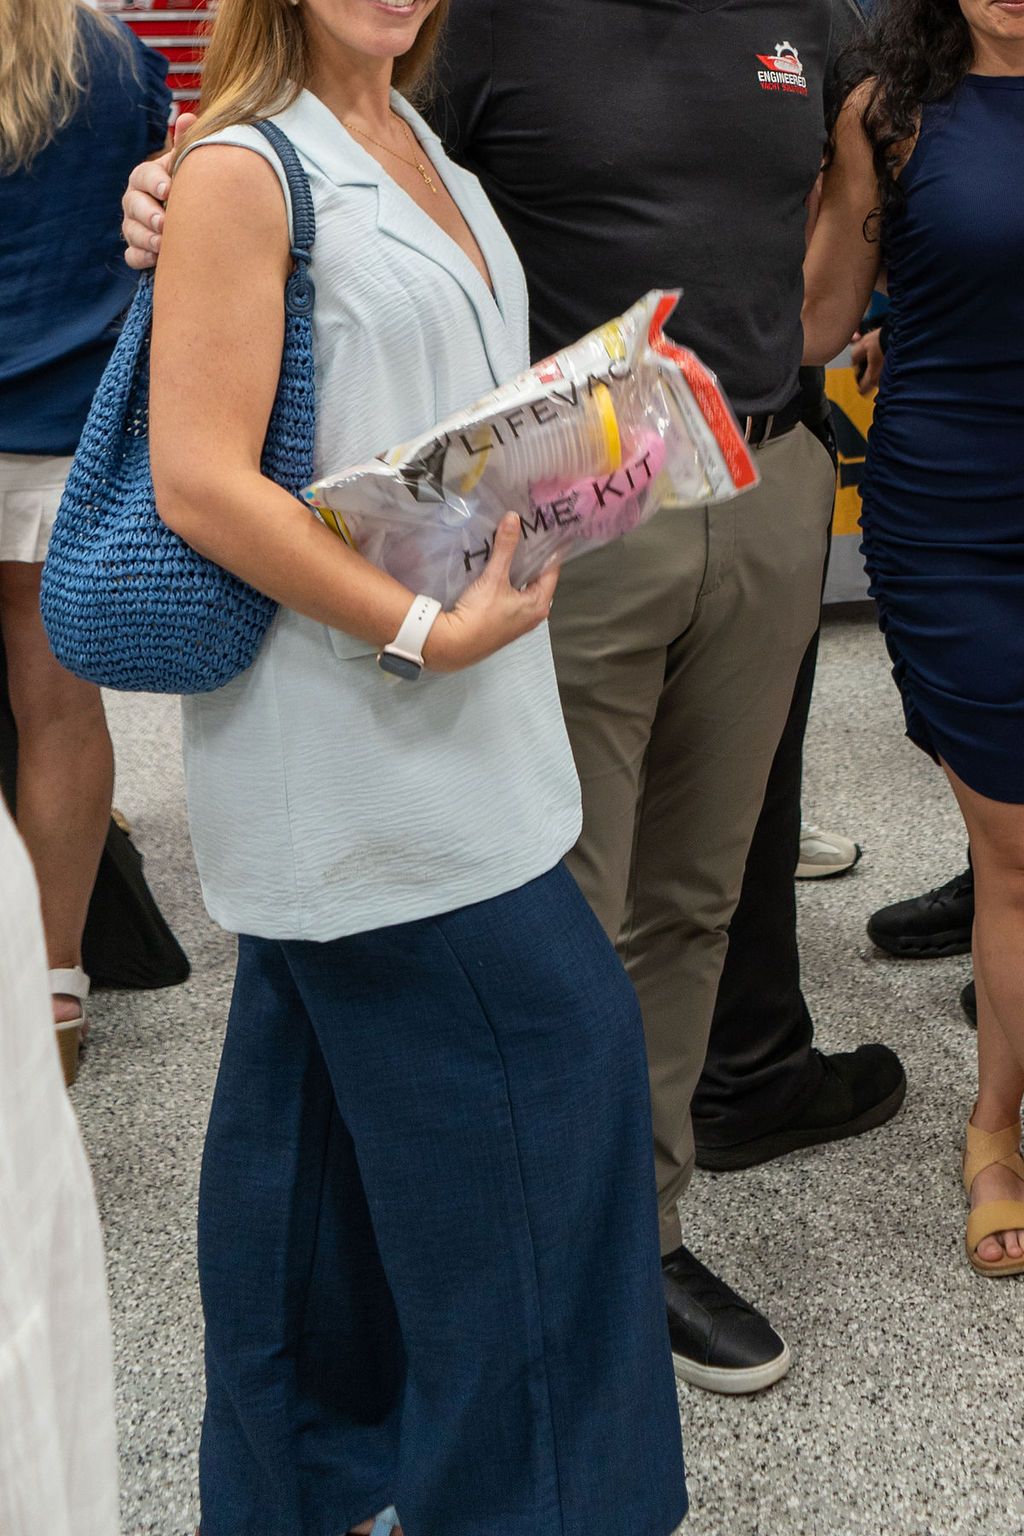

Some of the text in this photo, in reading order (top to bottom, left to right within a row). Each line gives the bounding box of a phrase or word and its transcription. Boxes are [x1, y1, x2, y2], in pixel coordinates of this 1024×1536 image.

[757, 70, 807, 88] ENGINEERED
[459, 362, 632, 457] LIFEVAC
[463, 451, 655, 573] HME KIT
